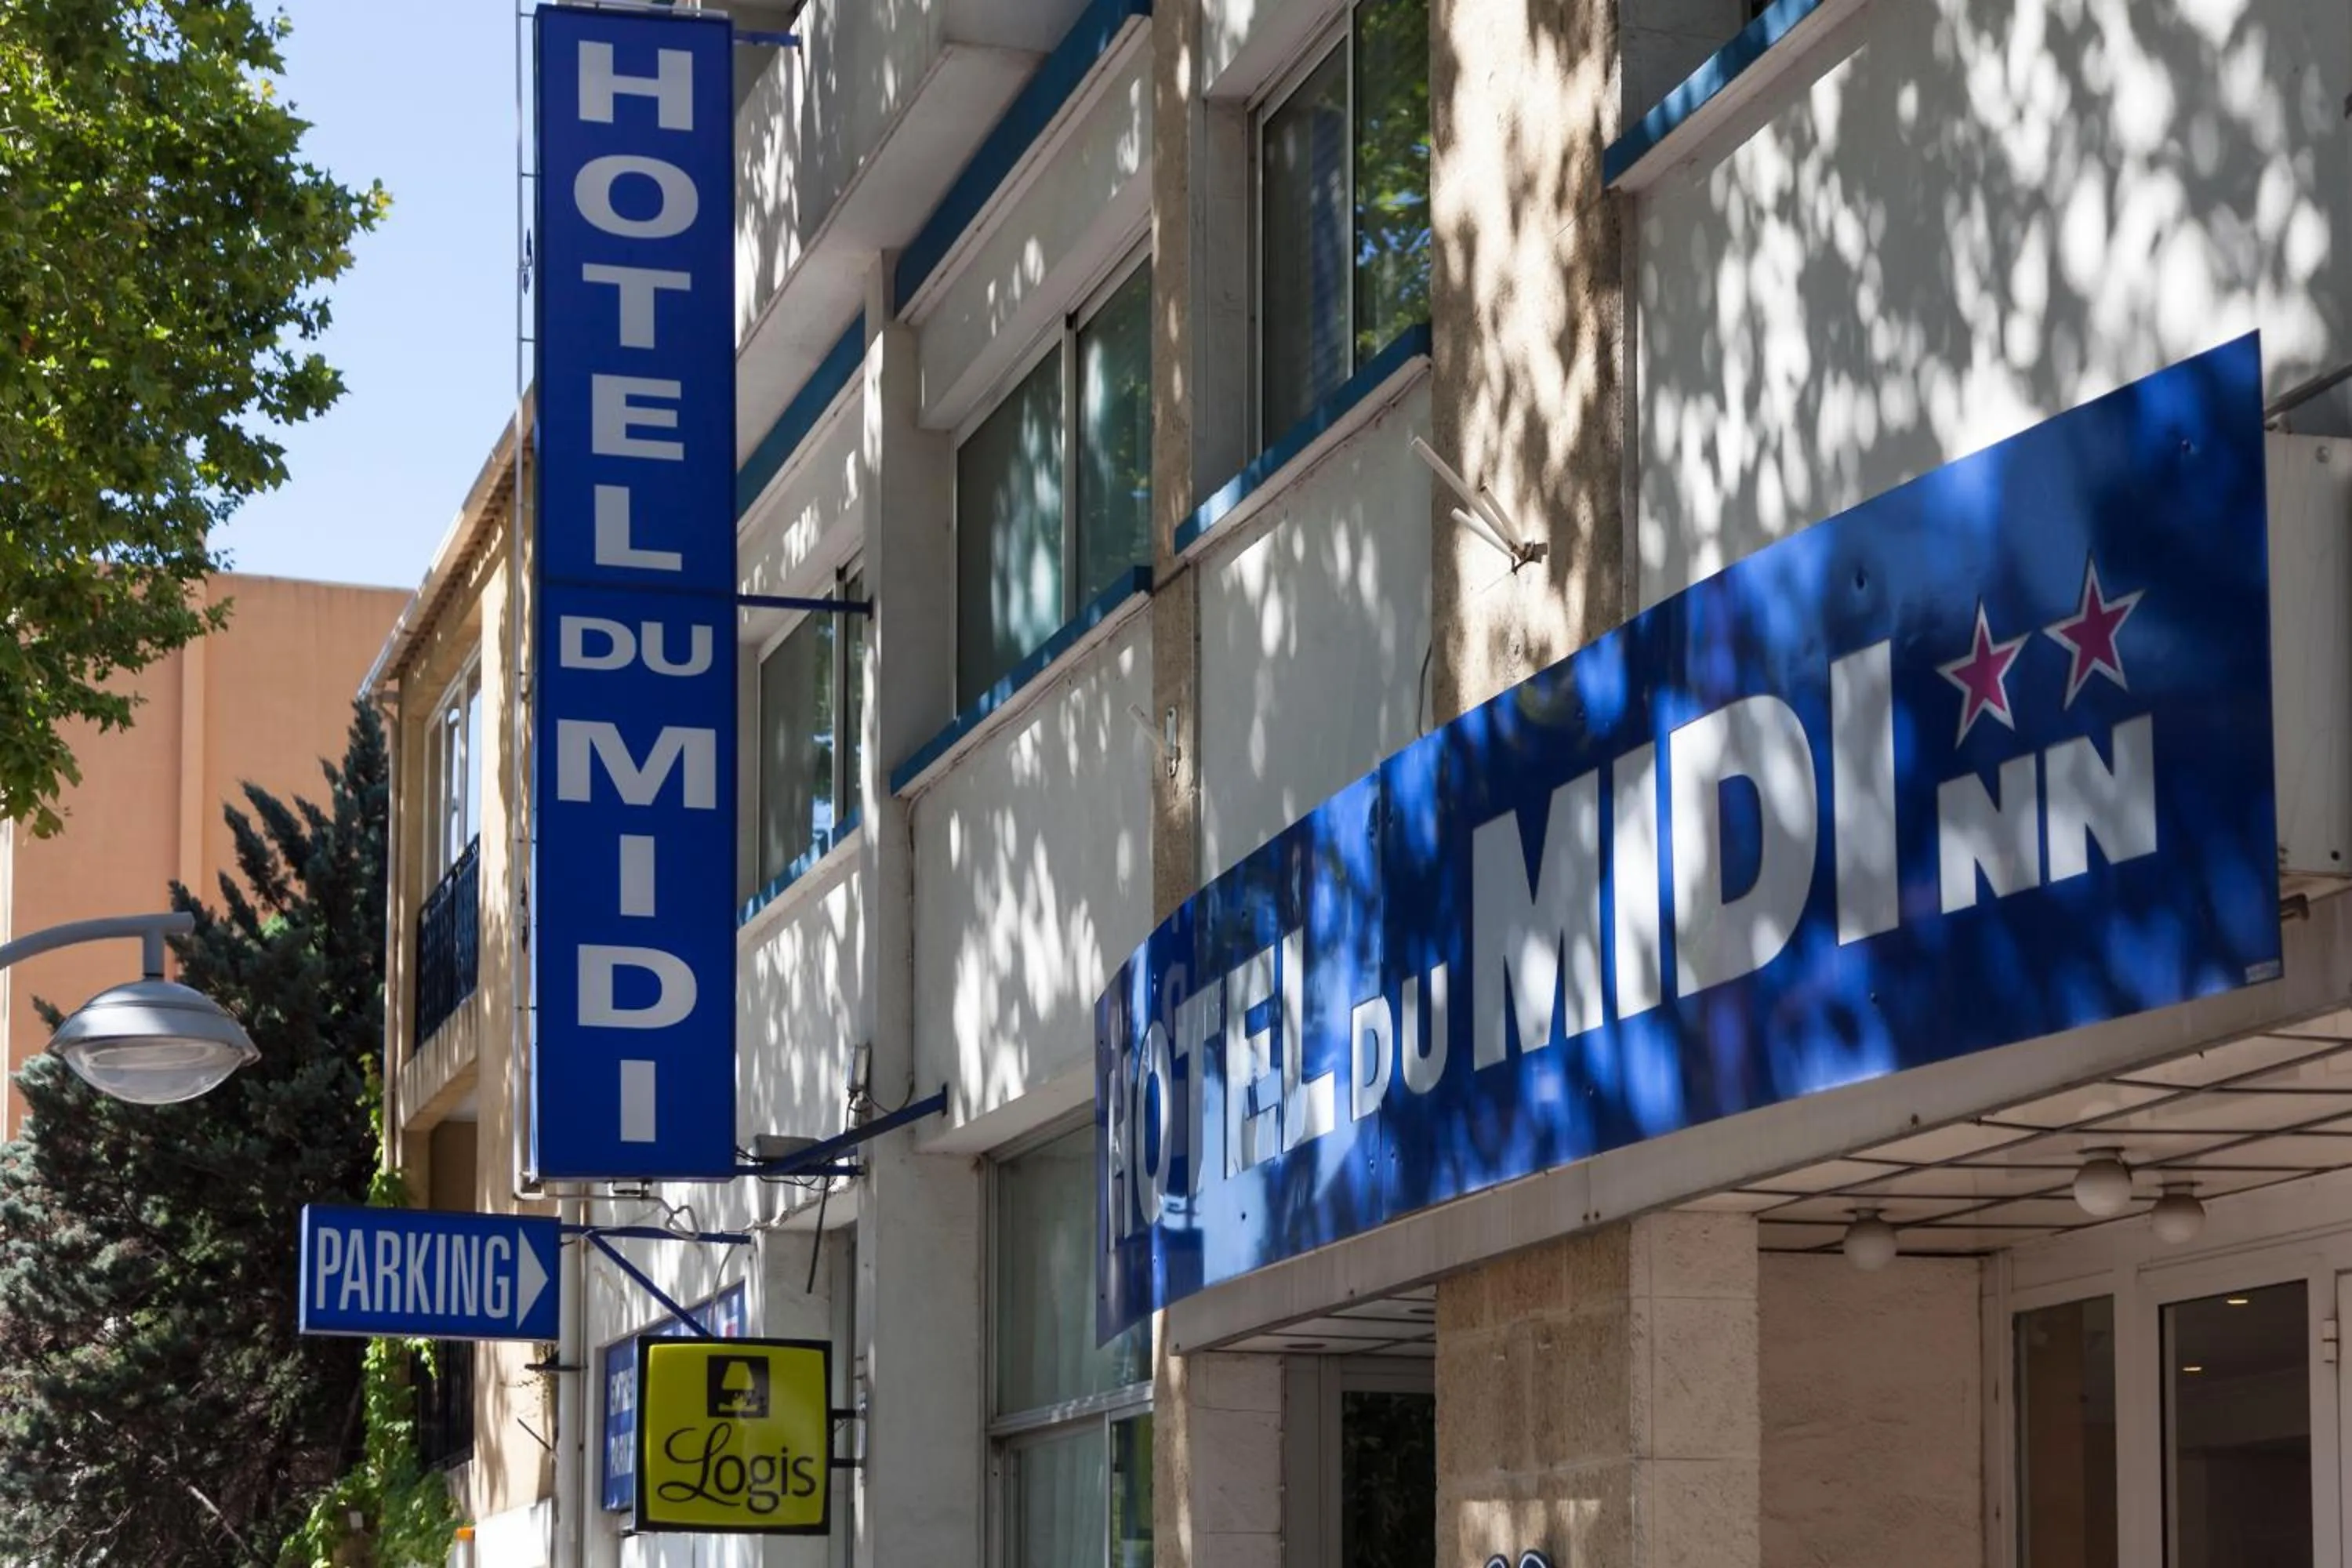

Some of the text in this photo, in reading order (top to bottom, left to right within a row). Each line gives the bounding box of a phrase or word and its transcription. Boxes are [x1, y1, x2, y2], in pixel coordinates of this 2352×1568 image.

[573, 40, 699, 572] HOTEL
[559, 615, 713, 677] DU
[557, 718, 717, 1143] MIDI
[1108, 639, 2158, 1252] HOTEL DU MIDI NN
[315, 1227, 511, 1319] PARKING
[657, 1421, 816, 1515] Logis
